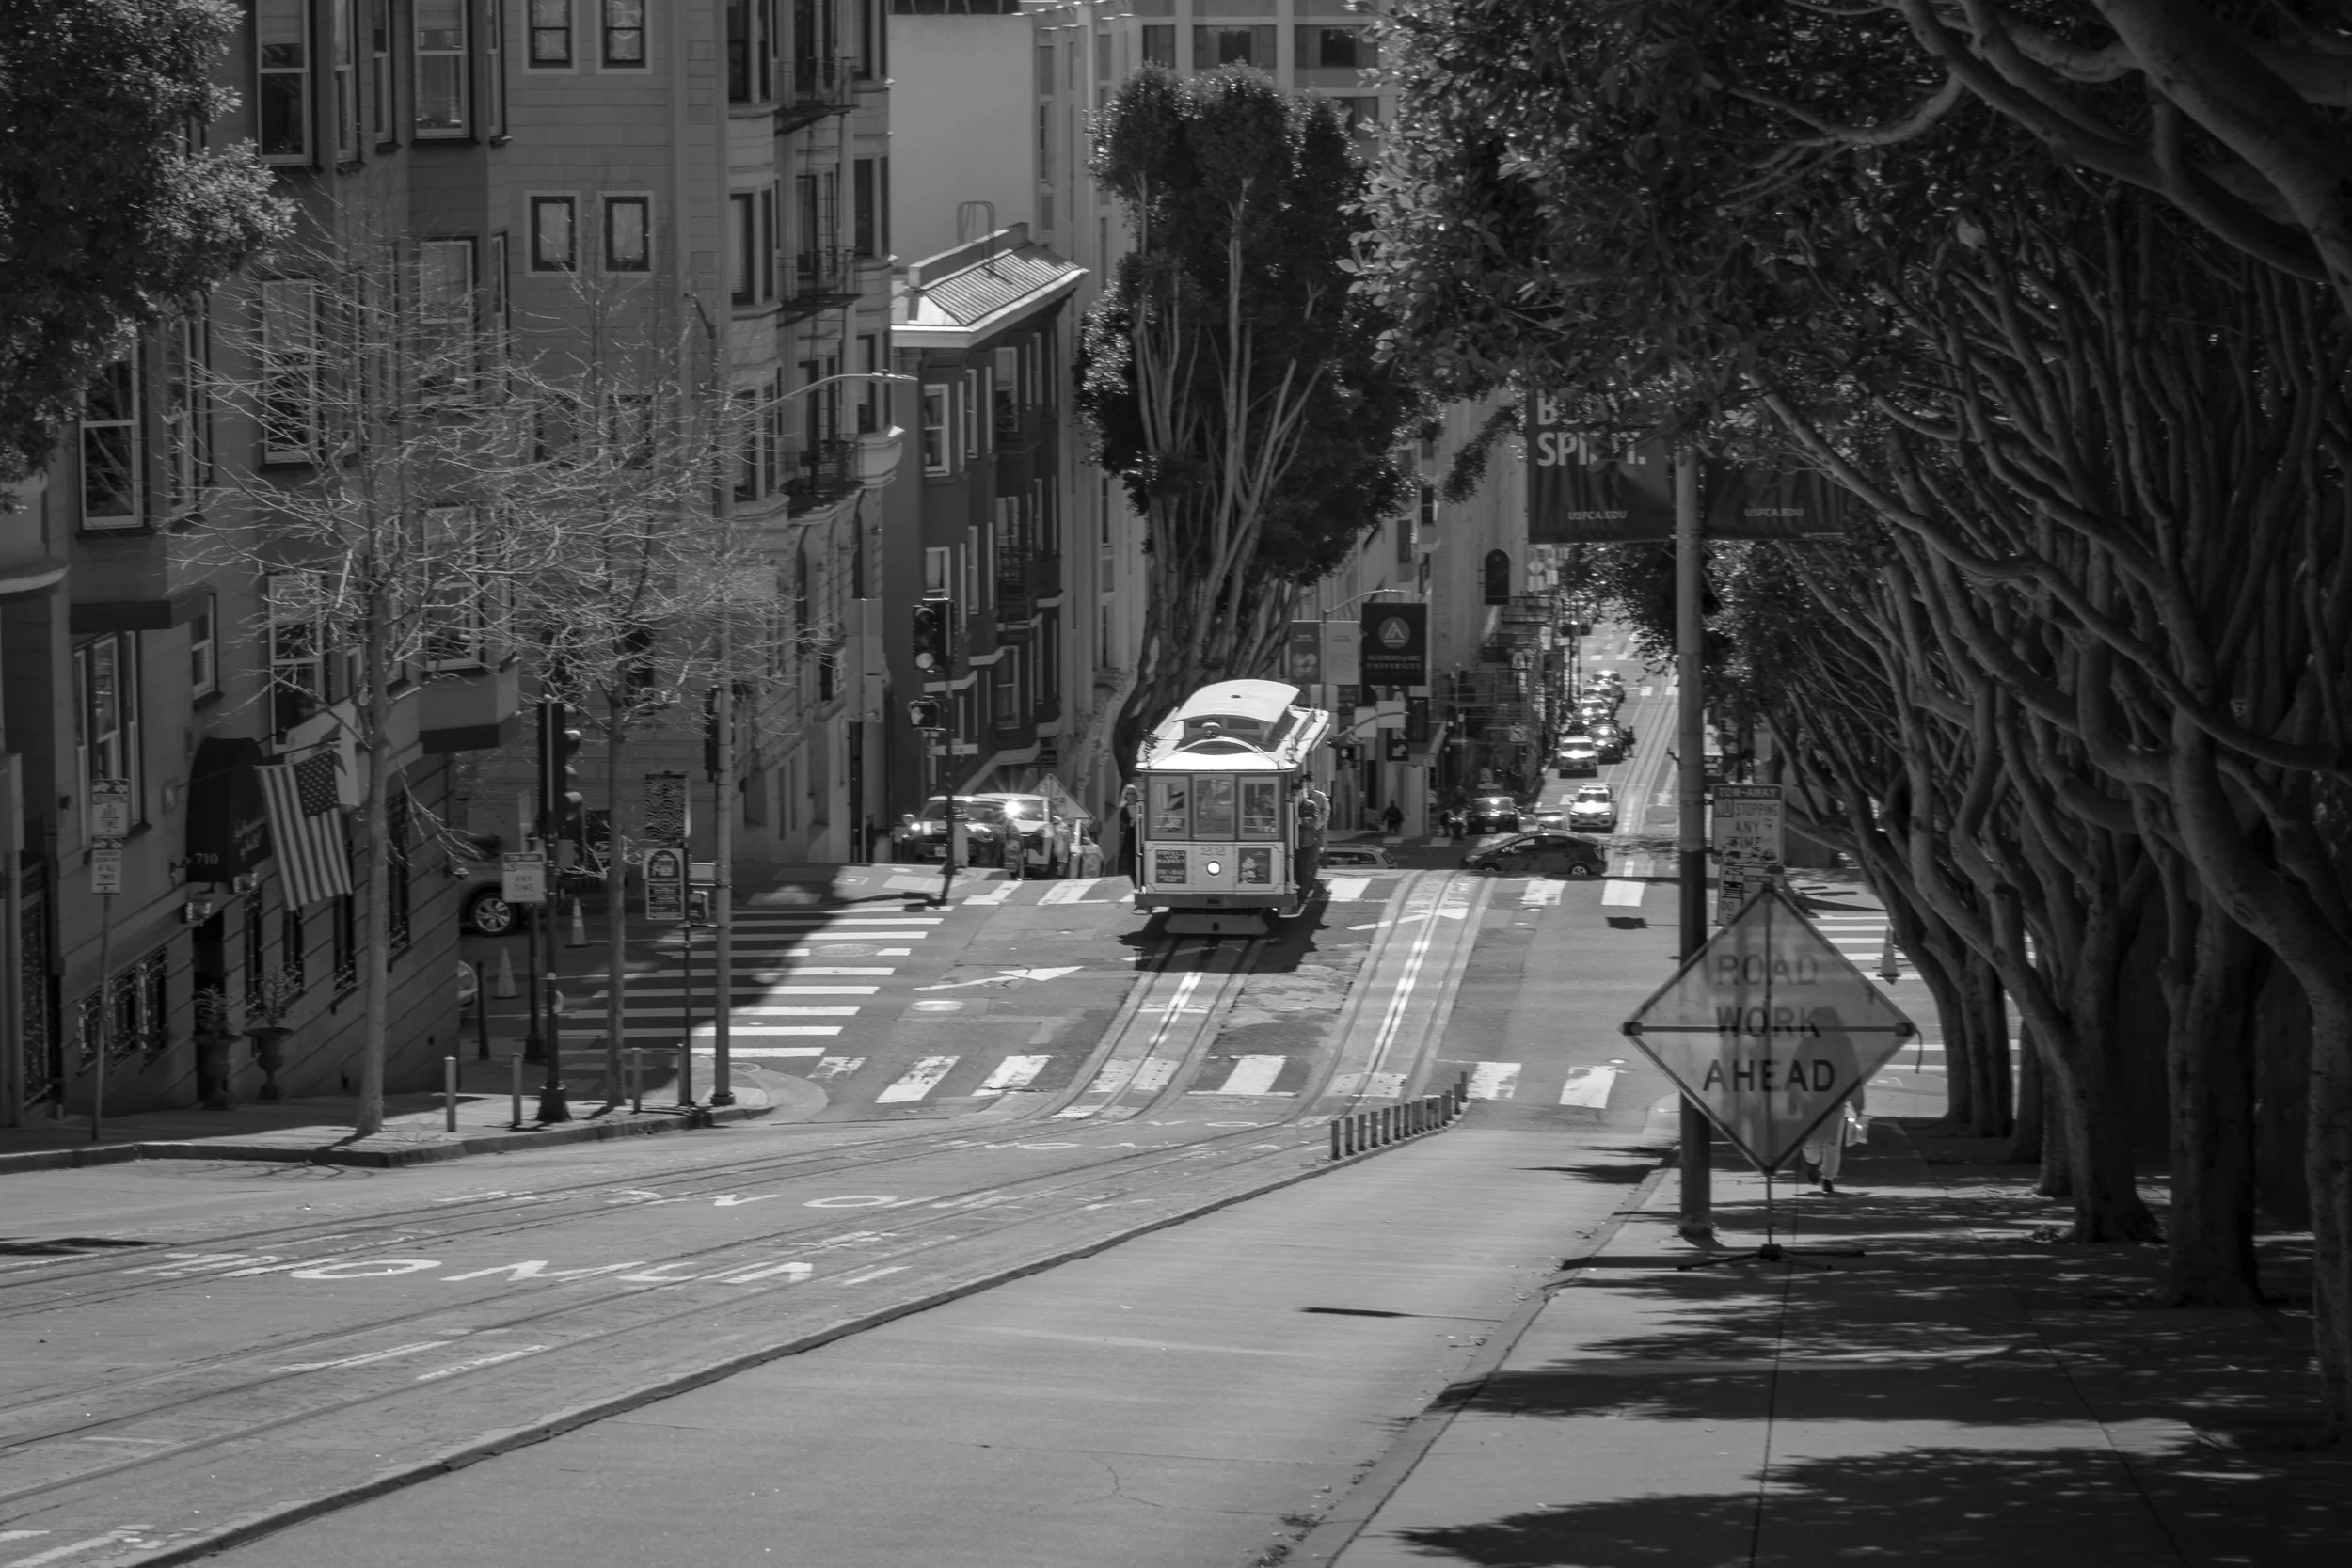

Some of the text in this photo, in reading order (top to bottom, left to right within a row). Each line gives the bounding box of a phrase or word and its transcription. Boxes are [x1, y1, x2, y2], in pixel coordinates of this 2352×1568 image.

[1567, 510, 1628, 521] USFCA.EDU
[1744, 507, 1804, 518] USFCA.EDU
[1735, 802, 1779, 816] STOPPING
[1735, 819, 1760, 832] ANY
[1200, 845, 1227, 857] 22
[195, 852, 219, 865] 710
[1718, 954, 1819, 985] ROAD
[1716, 1006, 1821, 1038] WORK
[1703, 1059, 1836, 1092] AHEAD
